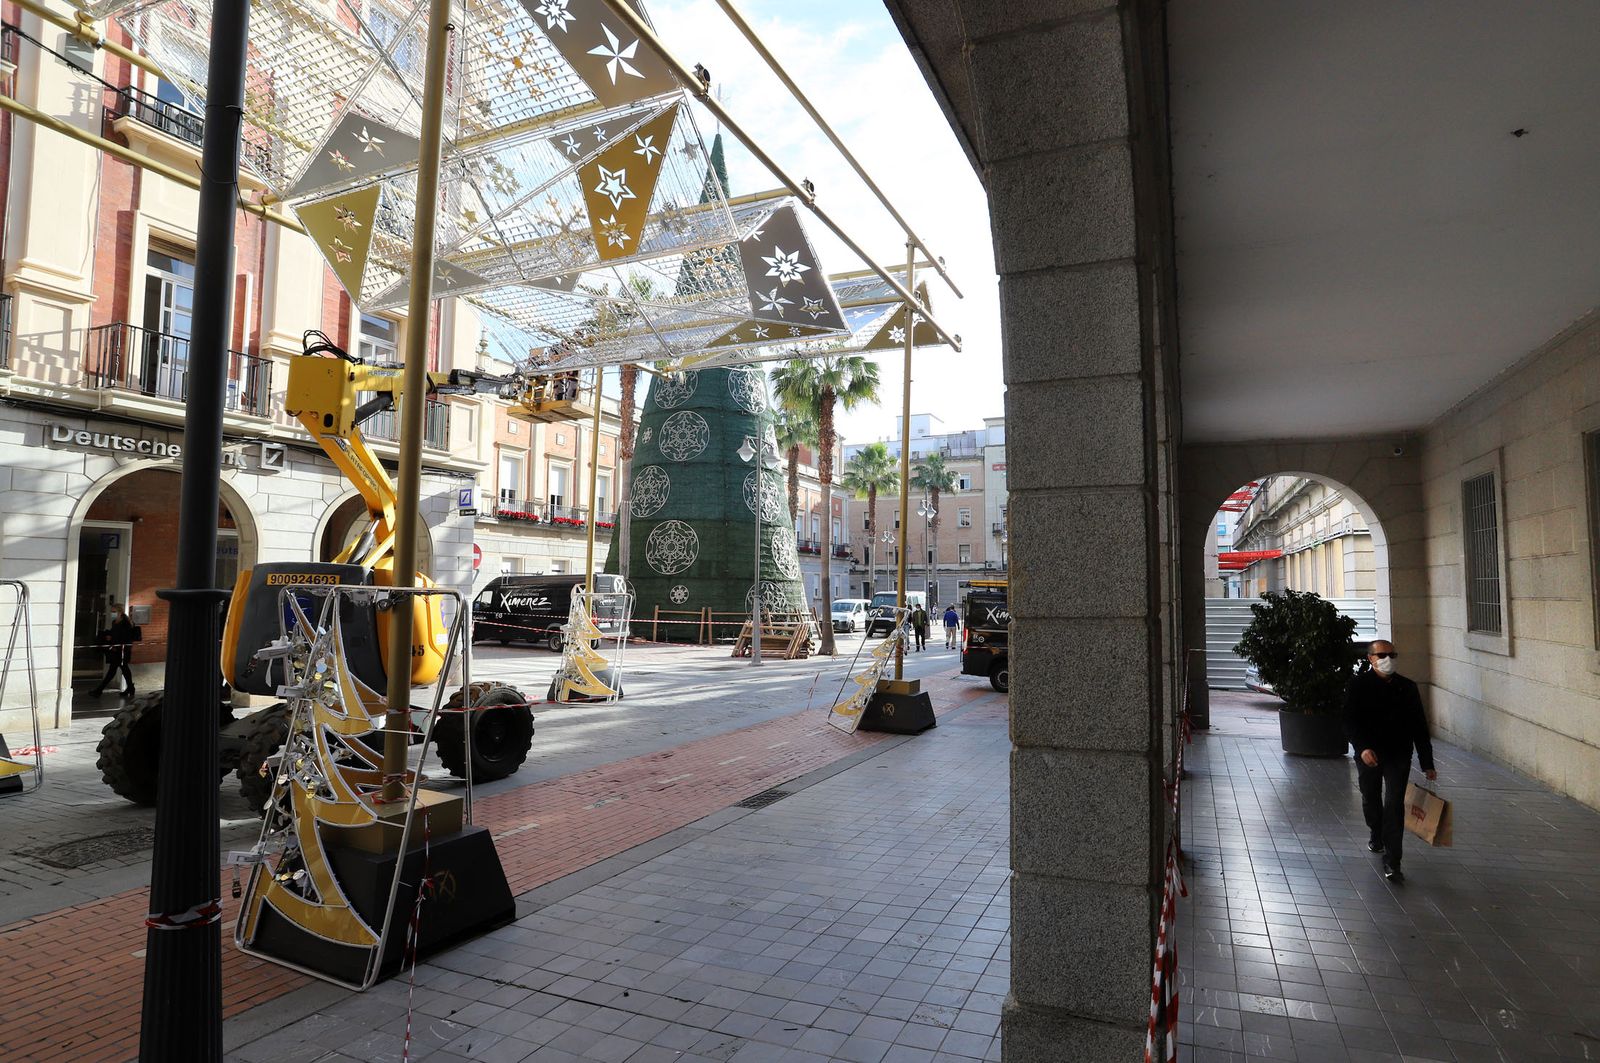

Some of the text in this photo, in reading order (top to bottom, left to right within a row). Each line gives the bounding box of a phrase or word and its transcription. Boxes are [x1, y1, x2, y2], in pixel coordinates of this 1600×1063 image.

[52, 425, 182, 458] Deutsche
[270, 574, 337, 585] 900924603
[500, 590, 552, 613] Ximenez
